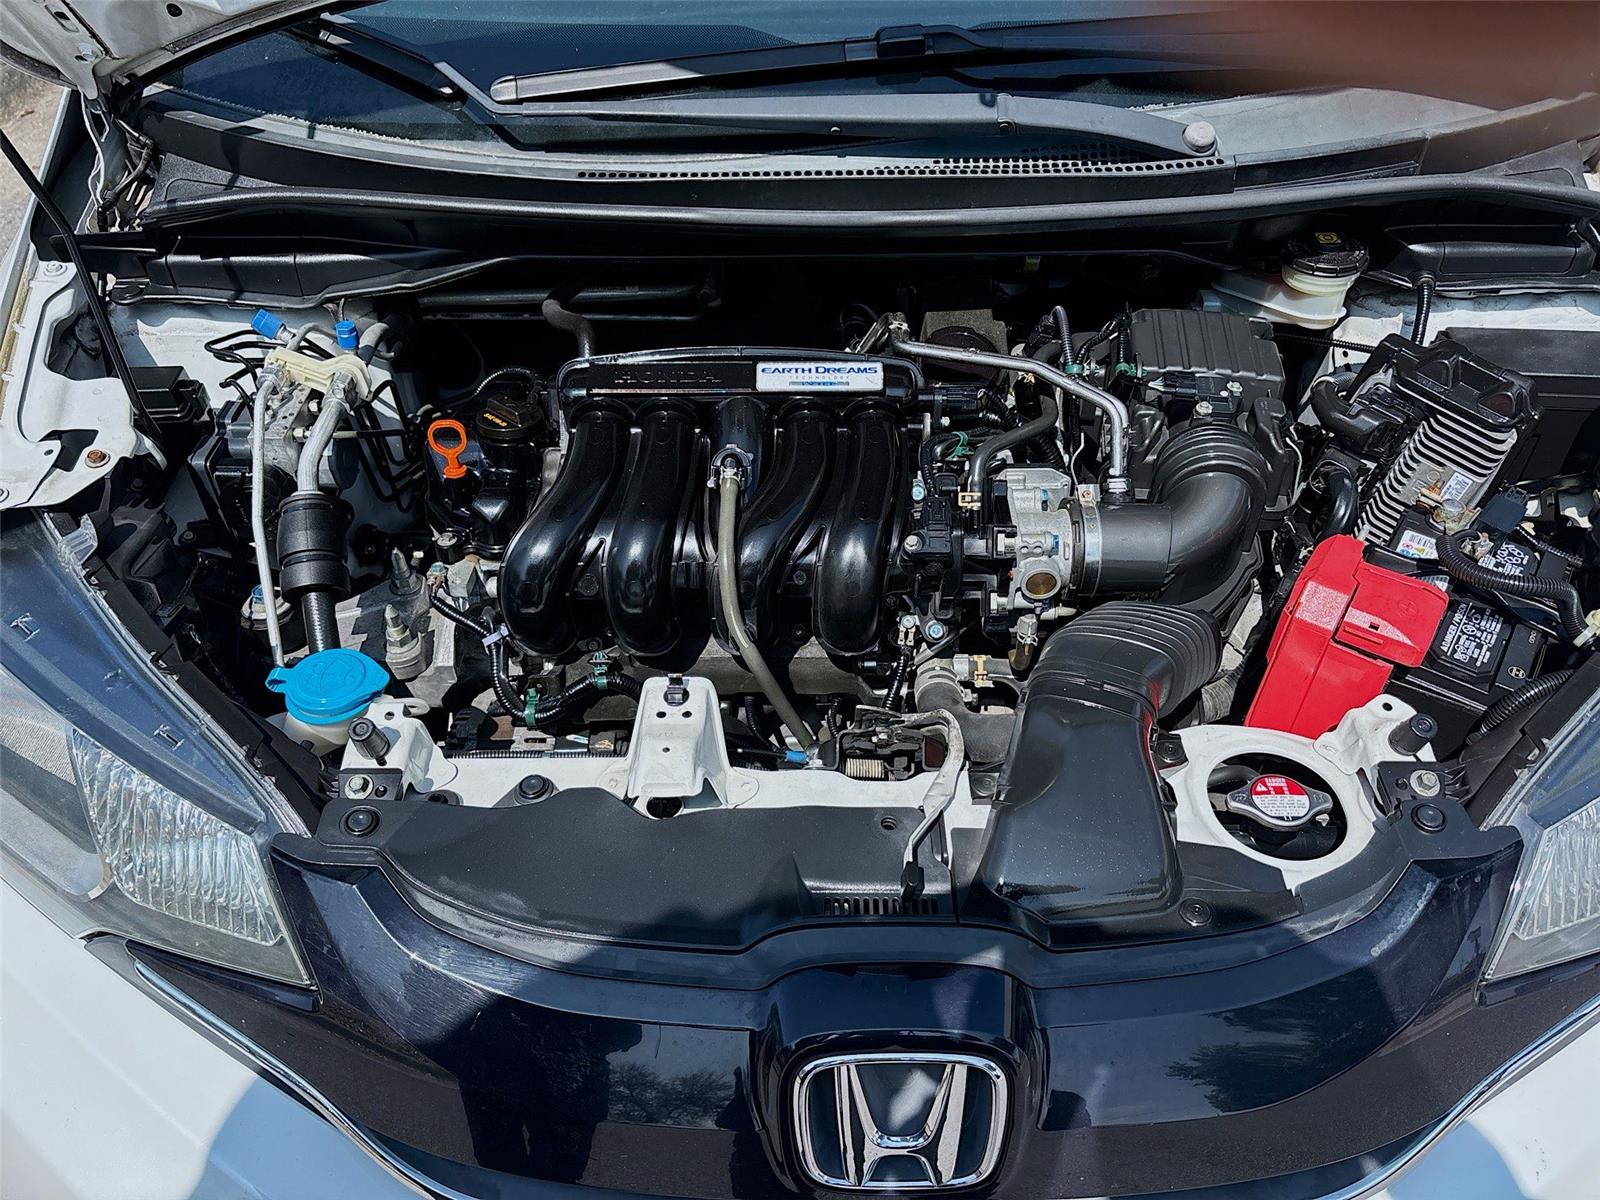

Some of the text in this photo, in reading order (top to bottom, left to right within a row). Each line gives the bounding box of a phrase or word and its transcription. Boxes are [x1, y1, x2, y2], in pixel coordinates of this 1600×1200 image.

[815, 366, 878, 374] DREAMS
[614, 371, 722, 382] HONDA
[1441, 624, 1458, 649] DANGER
[1453, 603, 1468, 623] POISON
